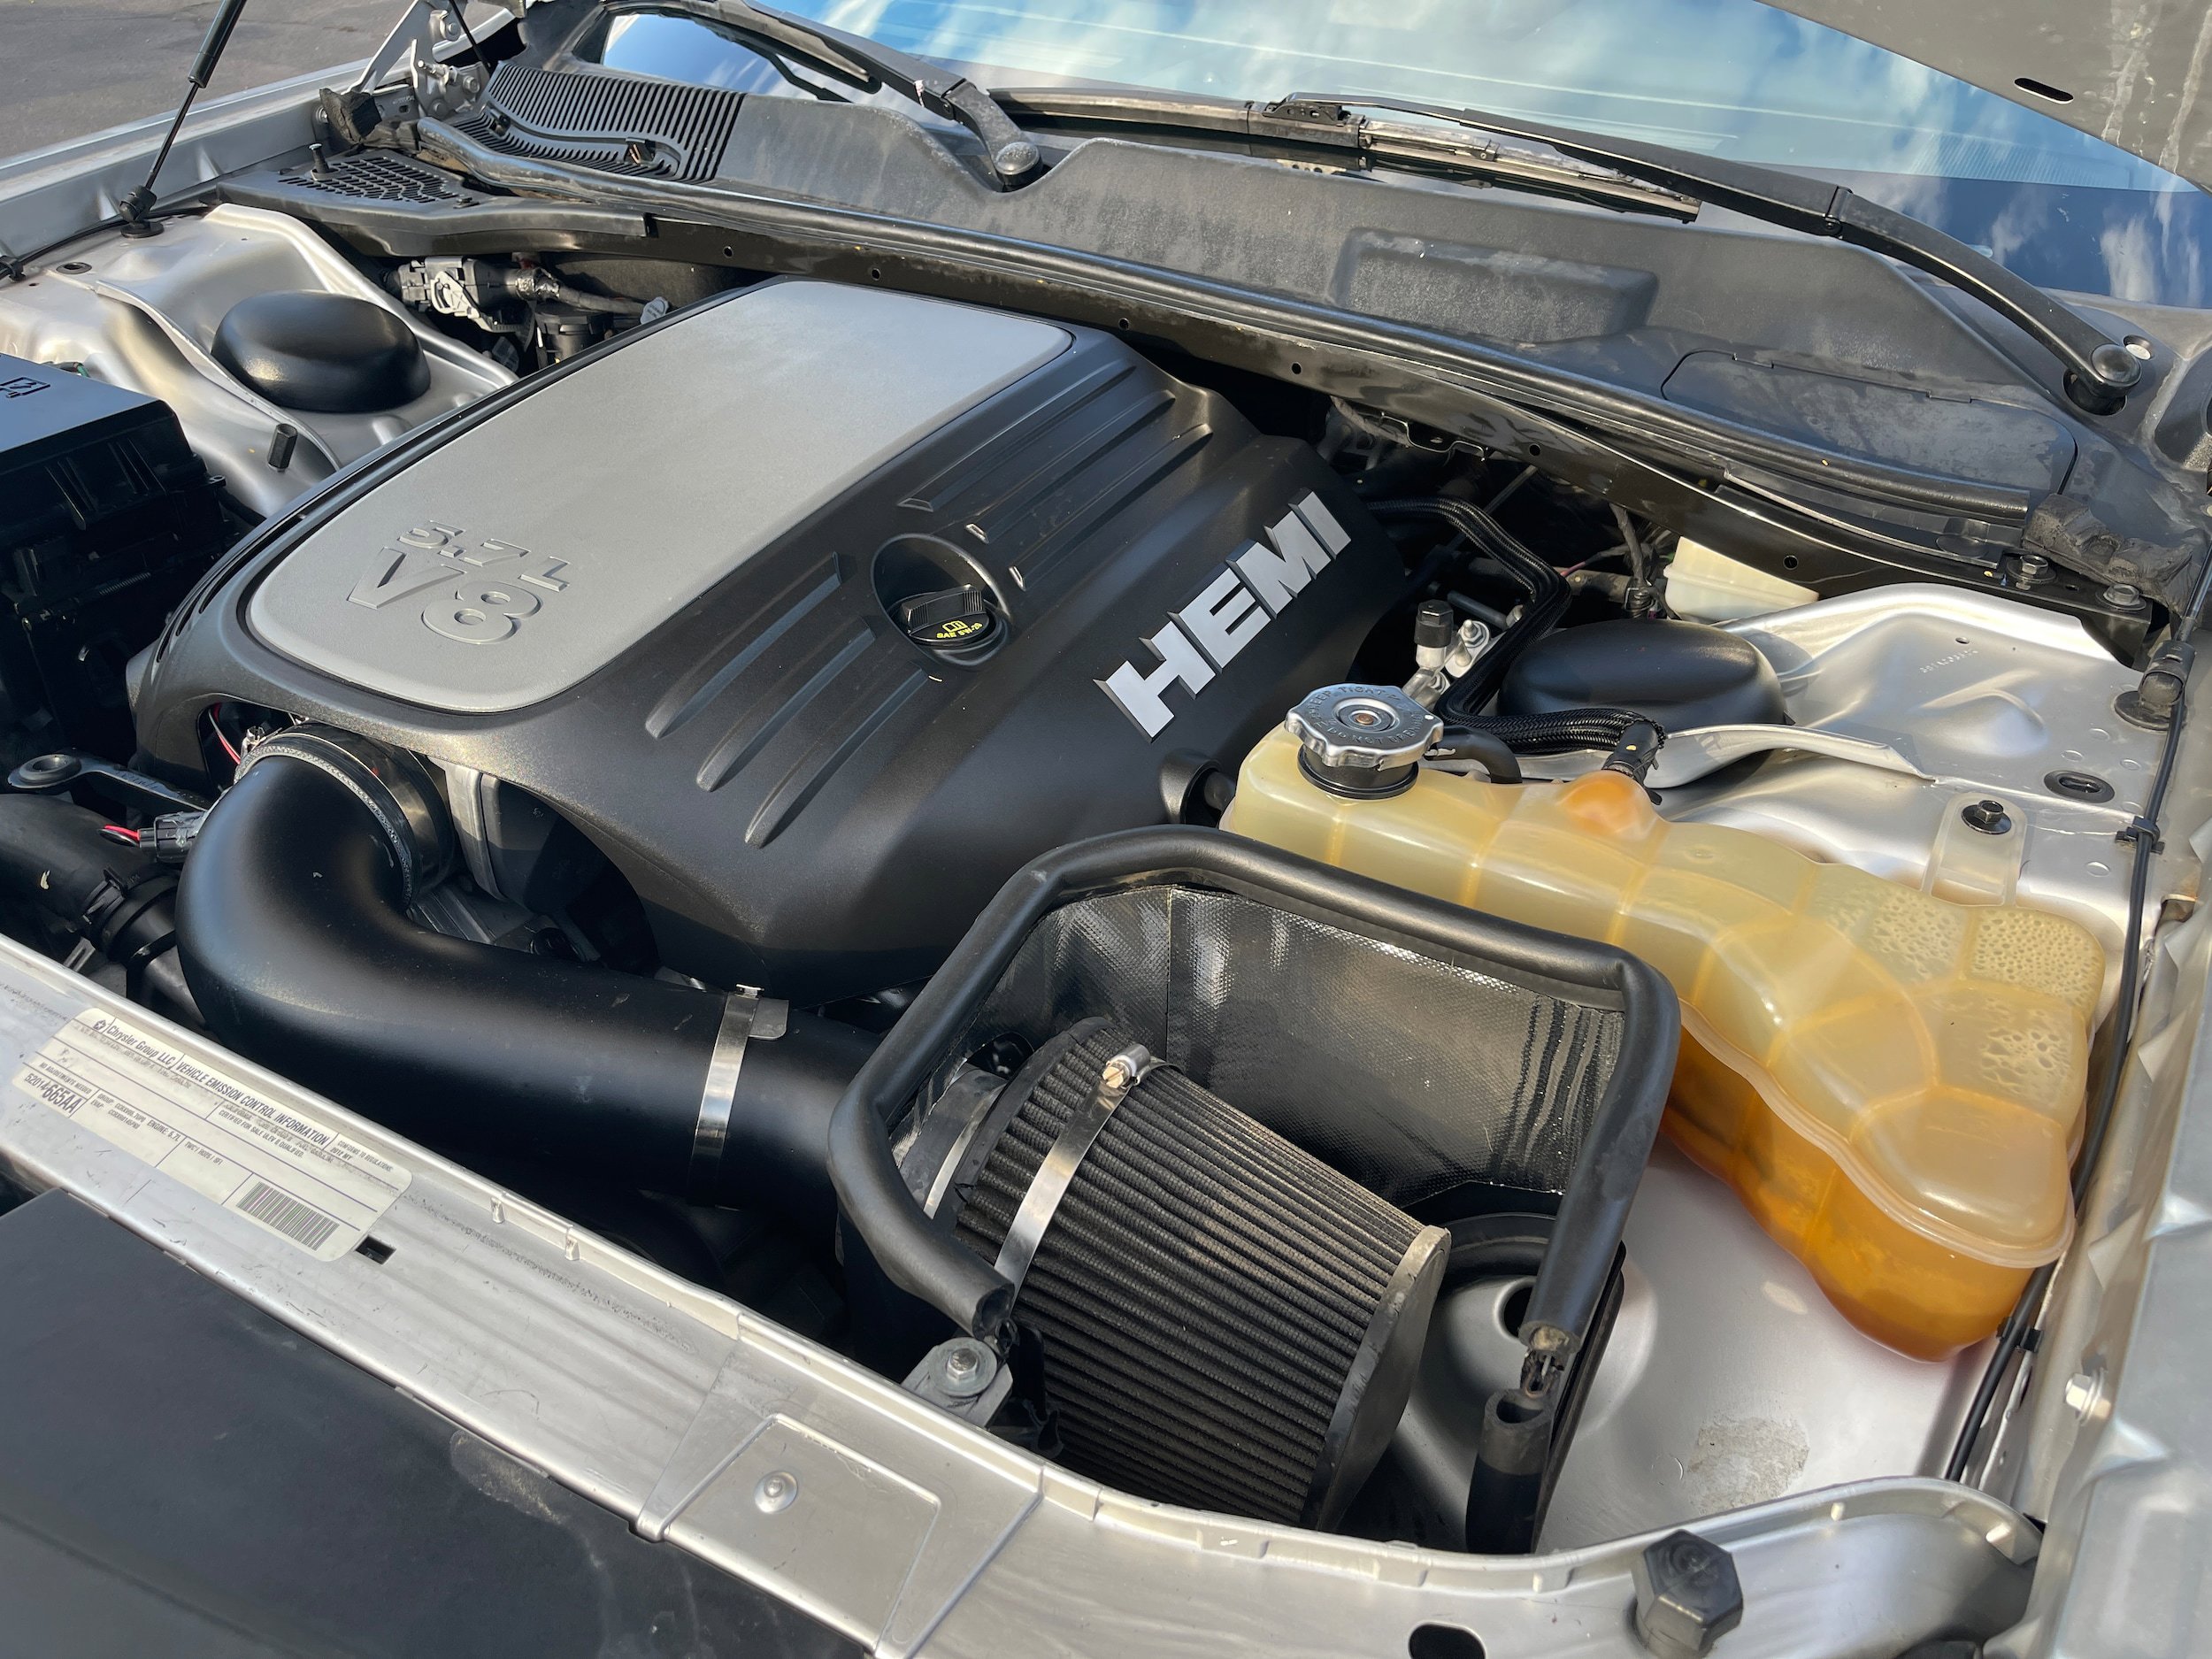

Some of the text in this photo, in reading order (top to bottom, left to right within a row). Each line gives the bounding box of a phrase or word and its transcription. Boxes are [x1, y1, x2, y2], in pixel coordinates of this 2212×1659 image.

[347, 546, 543, 644] V8
[396, 520, 571, 592] 5.7L
[1097, 489, 1351, 741] HEMI
[106, 1025, 138, 1046] Chrysler
[136, 1041, 160, 1058] Group
[157, 1051, 176, 1065] LLC
[174, 1061, 209, 1083] VEHICLE
[204, 1076, 244, 1101] EMISSION
[239, 1094, 278, 1118] CONTROL
[273, 1111, 330, 1146] INFORMATION
[218, 1109, 243, 1125] CERTIFIED
[240, 1121, 252, 1130] FOR
[250, 1125, 265, 1136] SALE
